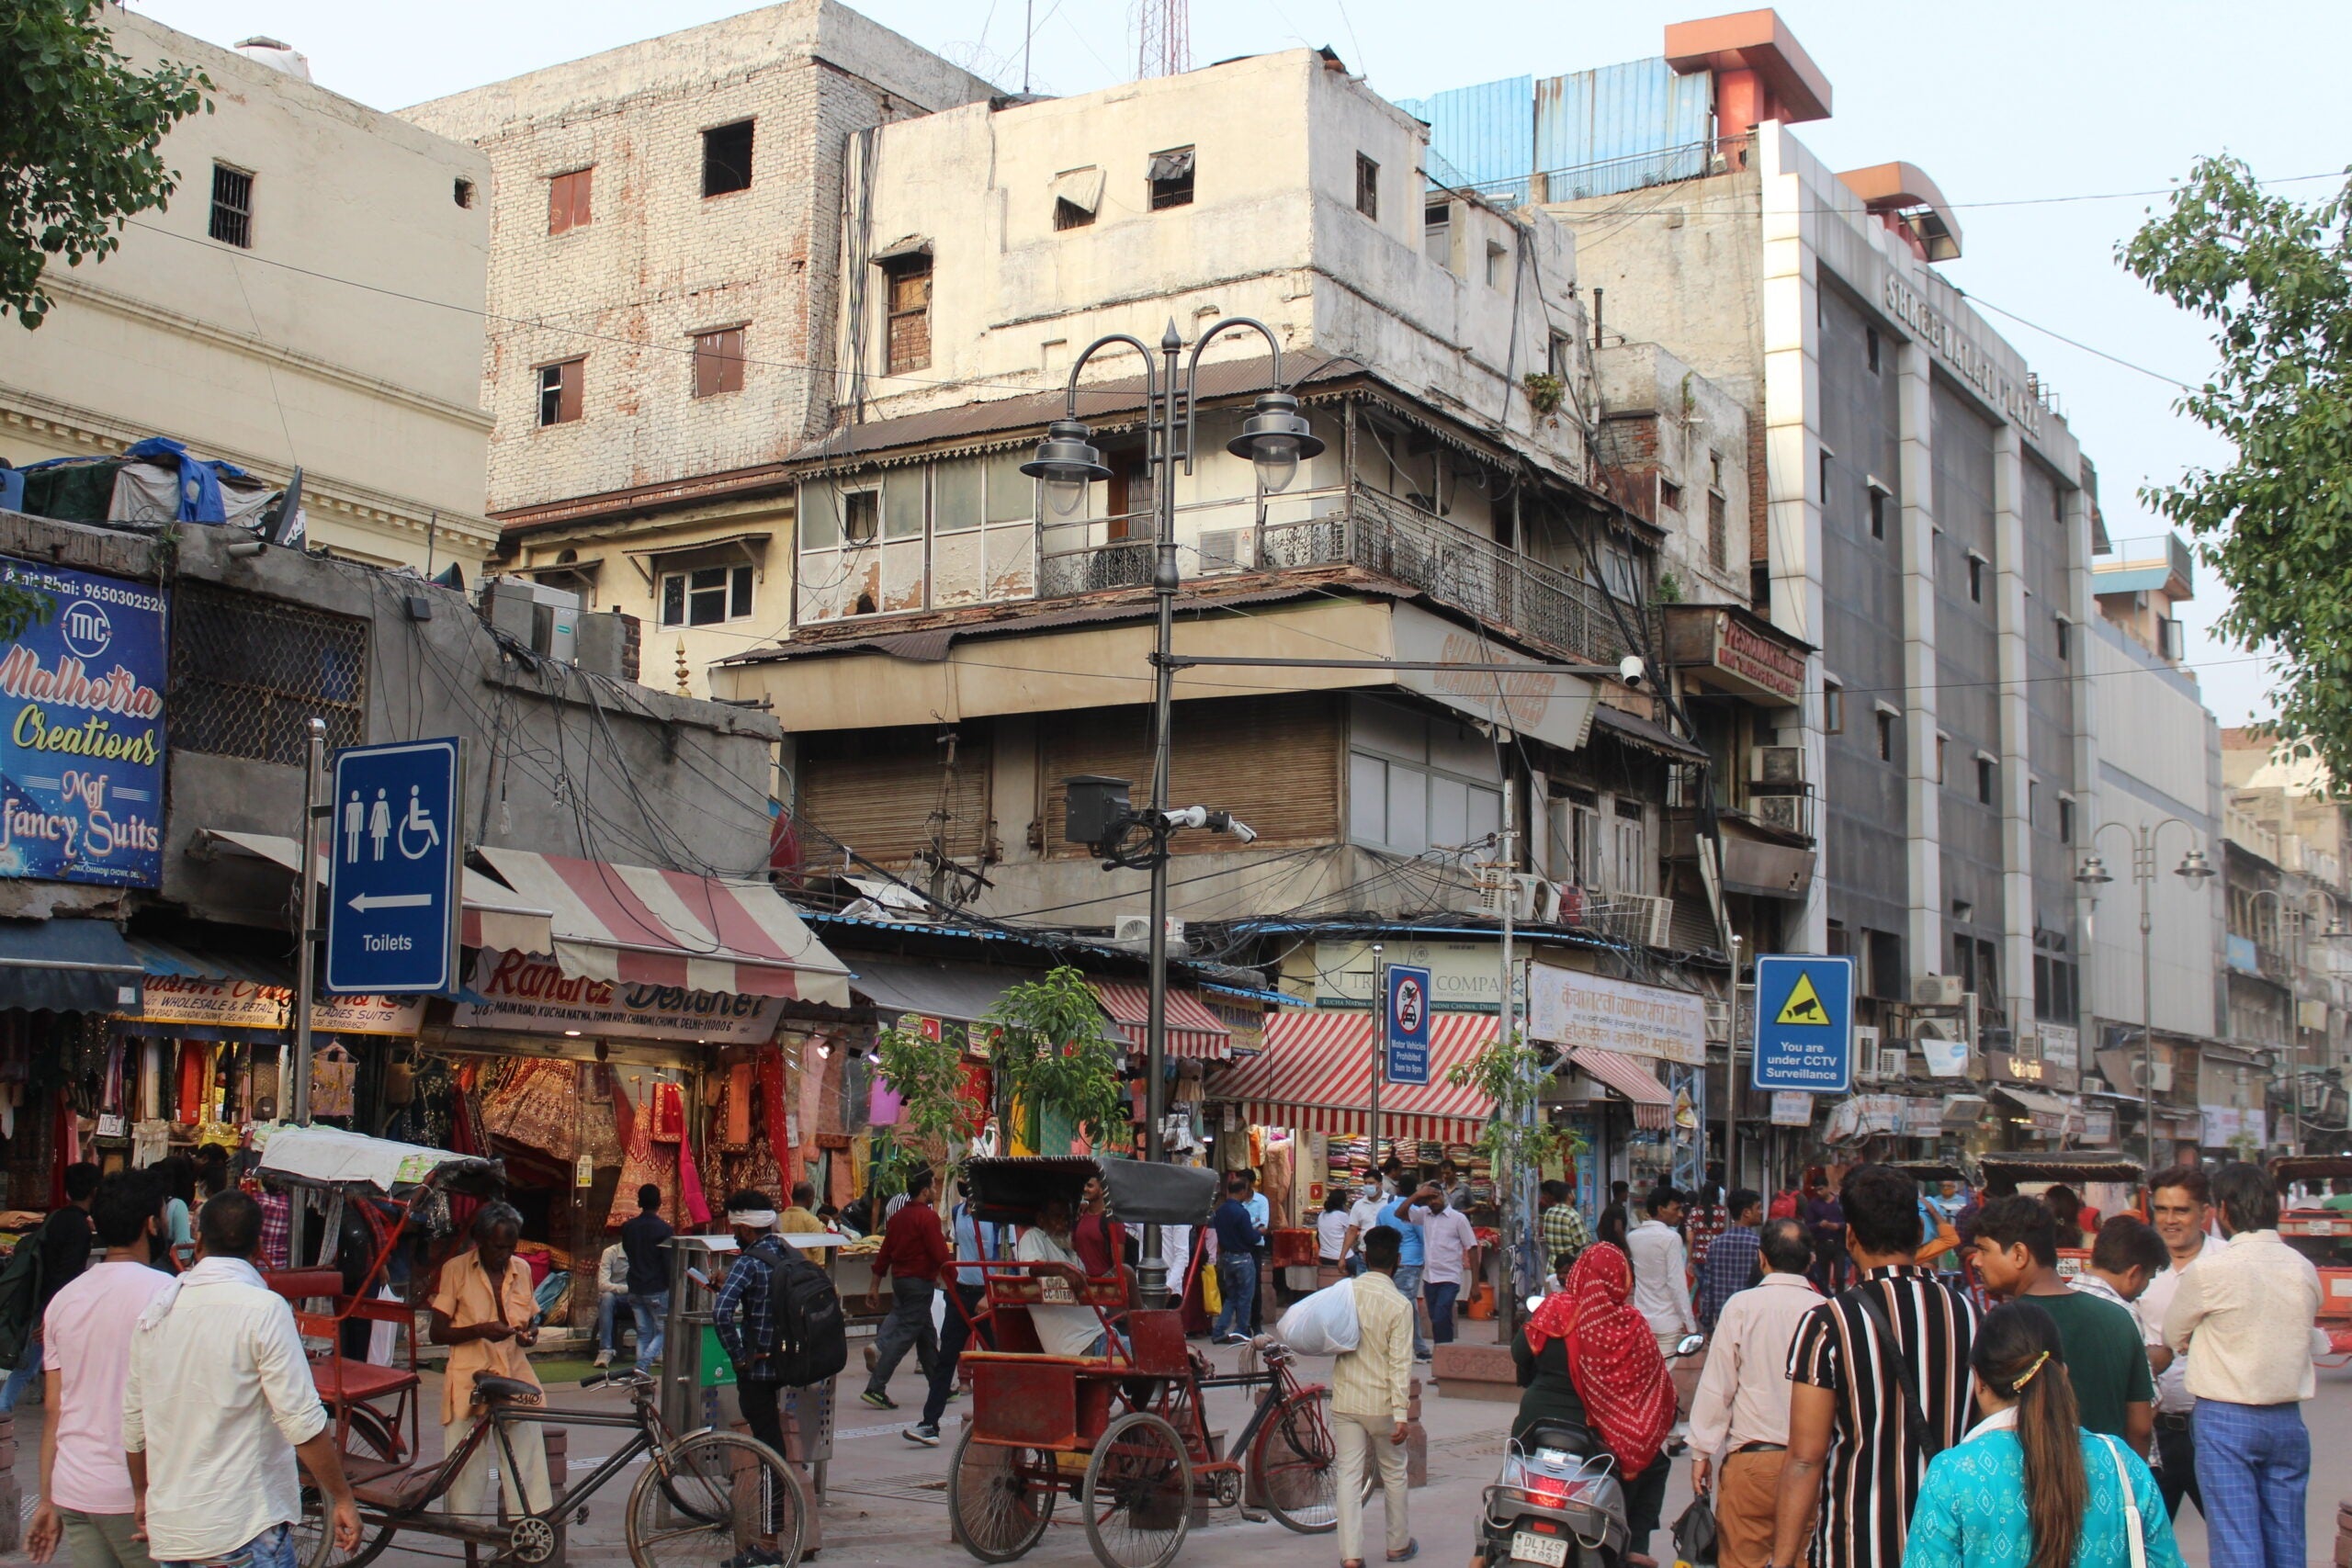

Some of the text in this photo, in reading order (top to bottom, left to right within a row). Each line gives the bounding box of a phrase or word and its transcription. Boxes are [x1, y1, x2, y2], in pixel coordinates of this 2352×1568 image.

[1887, 274, 2041, 440] SHREE BALAJI PLAZA
[85, 583, 166, 614] 9650302526
[0, 644, 164, 719] Malhotra
[13, 704, 161, 765] Creations
[85, 810, 160, 856] Suits
[363, 934, 413, 952] Toilets
[1436, 976, 1500, 993] COMPA
[161, 997, 229, 1011] WHOLESALE
[228, 1001, 238, 1011] &
[241, 1001, 275, 1014] RETAIL
[316, 1007, 395, 1021] LADIES SUITS
[494, 1001, 516, 1014] MAIN
[516, 1004, 537, 1018] ROAD,
[537, 1006, 566, 1019] KUCHA
[1391, 1039, 1426, 1051] Motor Vehicles
[1781, 1042, 1825, 1054] You are
[1396, 1051, 1421, 1062] Prohibited
[1767, 1055, 1838, 1066] under CCTV
[1766, 1067, 1838, 1080] Surveillance
